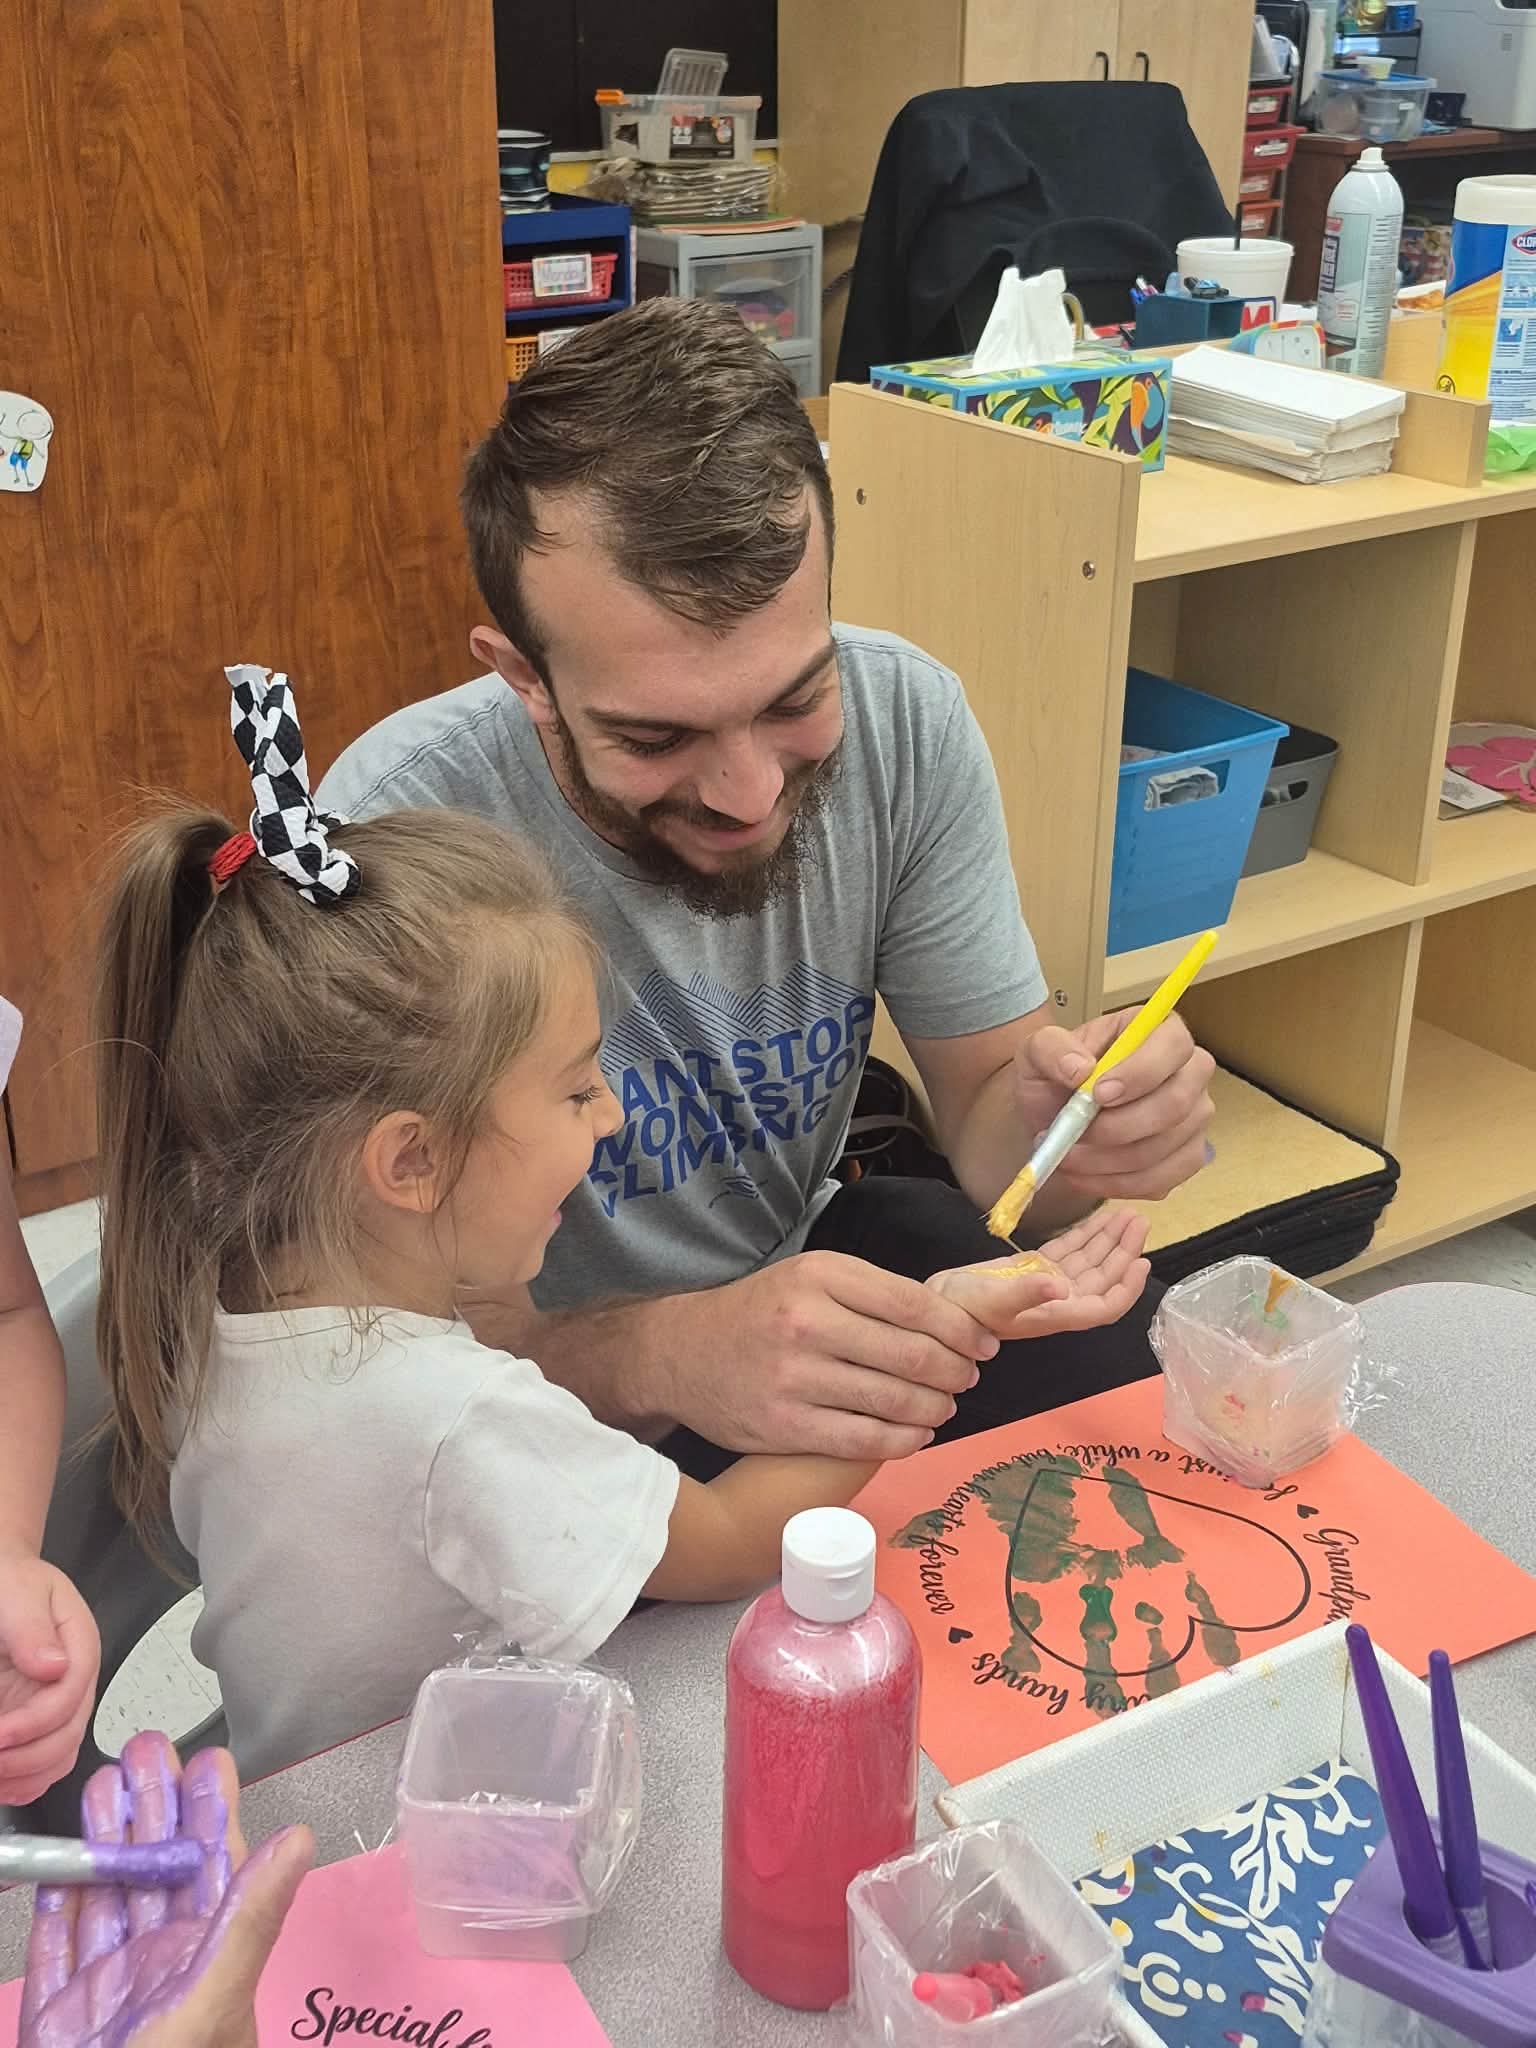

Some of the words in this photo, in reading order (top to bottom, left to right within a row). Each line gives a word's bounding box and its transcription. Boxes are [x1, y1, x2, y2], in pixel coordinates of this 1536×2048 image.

[622, 1050, 721, 1121] ANT
[731, 996, 876, 1086] STOP
[973, 1461, 1011, 1481] our
[1011, 1448, 1057, 1469] but
[1056, 1444, 1141, 1468] while,
[1147, 1449, 1170, 1463] a
[926, 1481, 991, 1533] hearts
[907, 1534, 959, 1615] forever
[1303, 1527, 1371, 1625] Grandpa
[971, 1652, 1069, 1716] hands
[290, 1986, 463, 2048] Special
